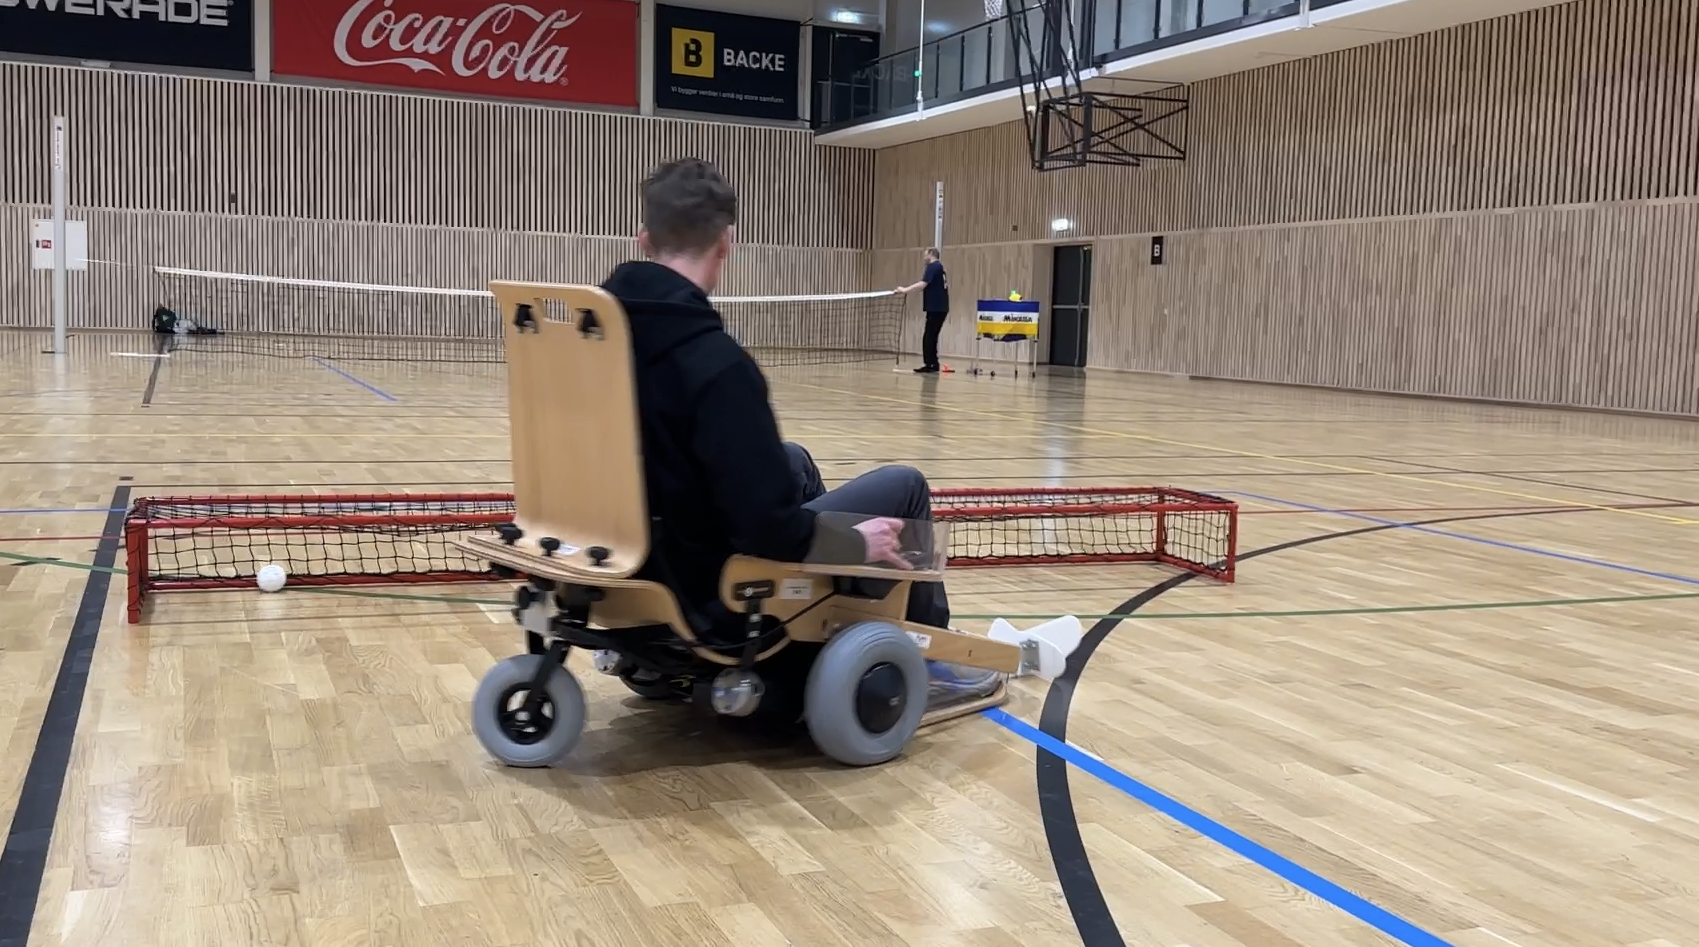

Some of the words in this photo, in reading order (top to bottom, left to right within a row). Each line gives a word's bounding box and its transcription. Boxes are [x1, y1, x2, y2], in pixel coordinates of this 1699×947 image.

[333, 0, 582, 84] Coca-Cola
[723, 48, 785, 72] BACKE
[1154, 244, 1161, 256] B
